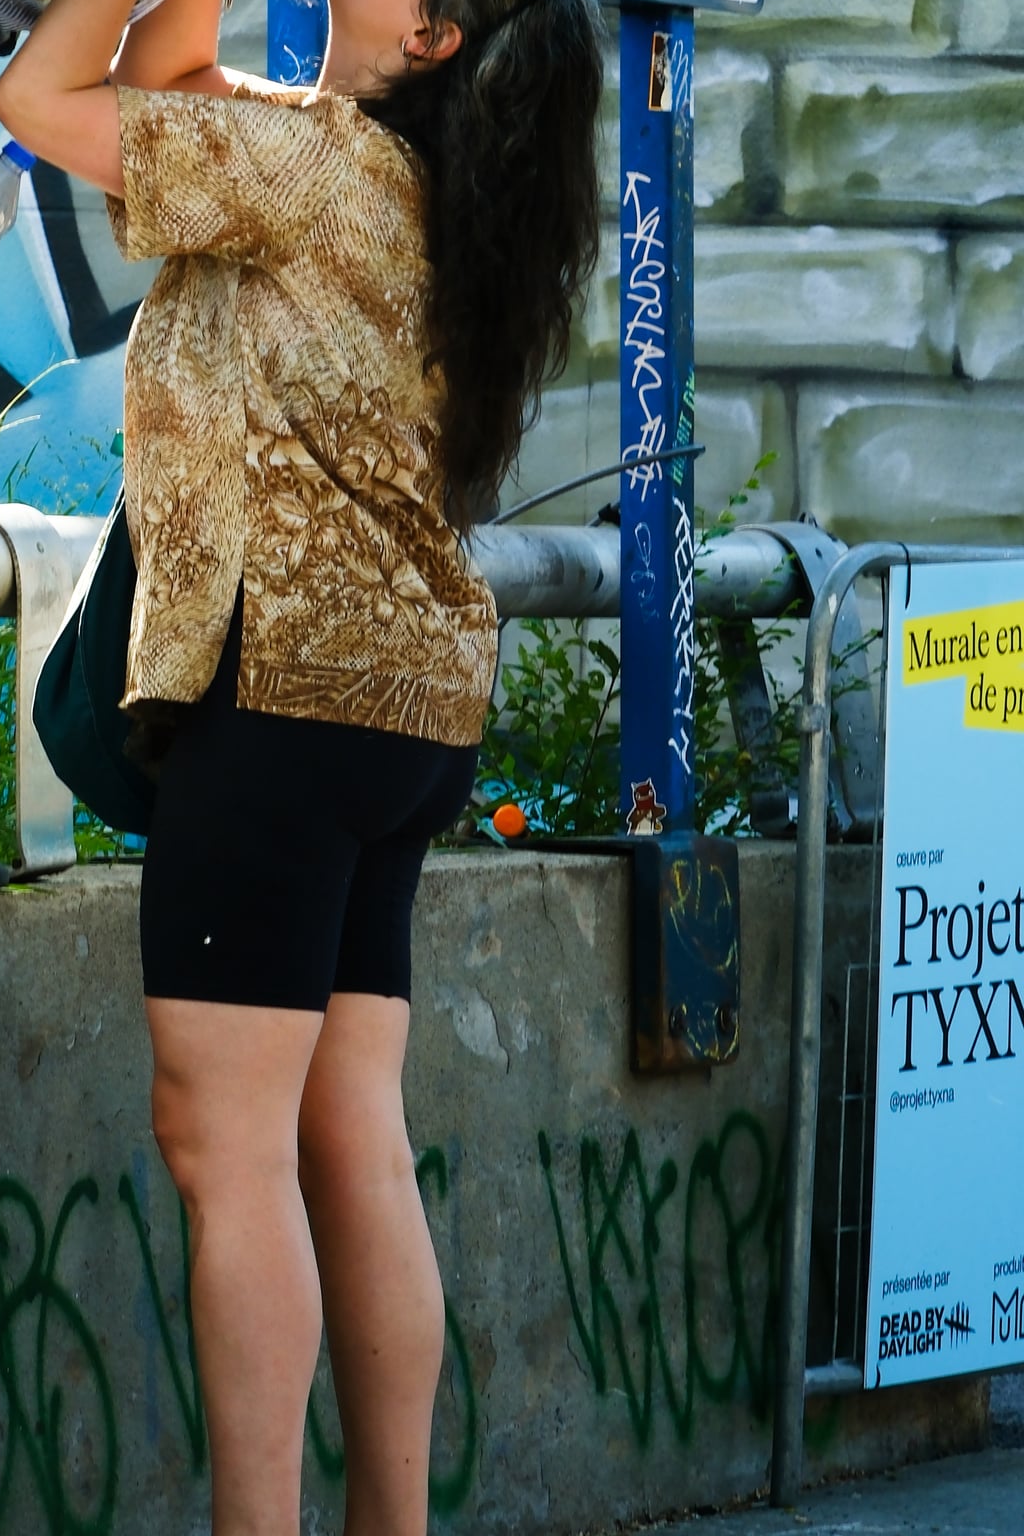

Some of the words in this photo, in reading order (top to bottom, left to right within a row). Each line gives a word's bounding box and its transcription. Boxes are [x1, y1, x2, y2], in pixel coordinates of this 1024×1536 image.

[908, 620, 990, 672] Murale
[996, 623, 1023, 654] en
[970, 671, 997, 712] de
[896, 850, 926, 868] œuvre
[928, 849, 944, 868] par
[893, 880, 1024, 978] Projet
[889, 1087, 955, 1113] @projet.tyxna
[882, 1270, 932, 1300] présentée
[934, 1271, 951, 1292] par
[880, 1309, 921, 1338] DEAD
[925, 1305, 945, 1331] BY
[878, 1329, 944, 1360] DAYLIGHT
